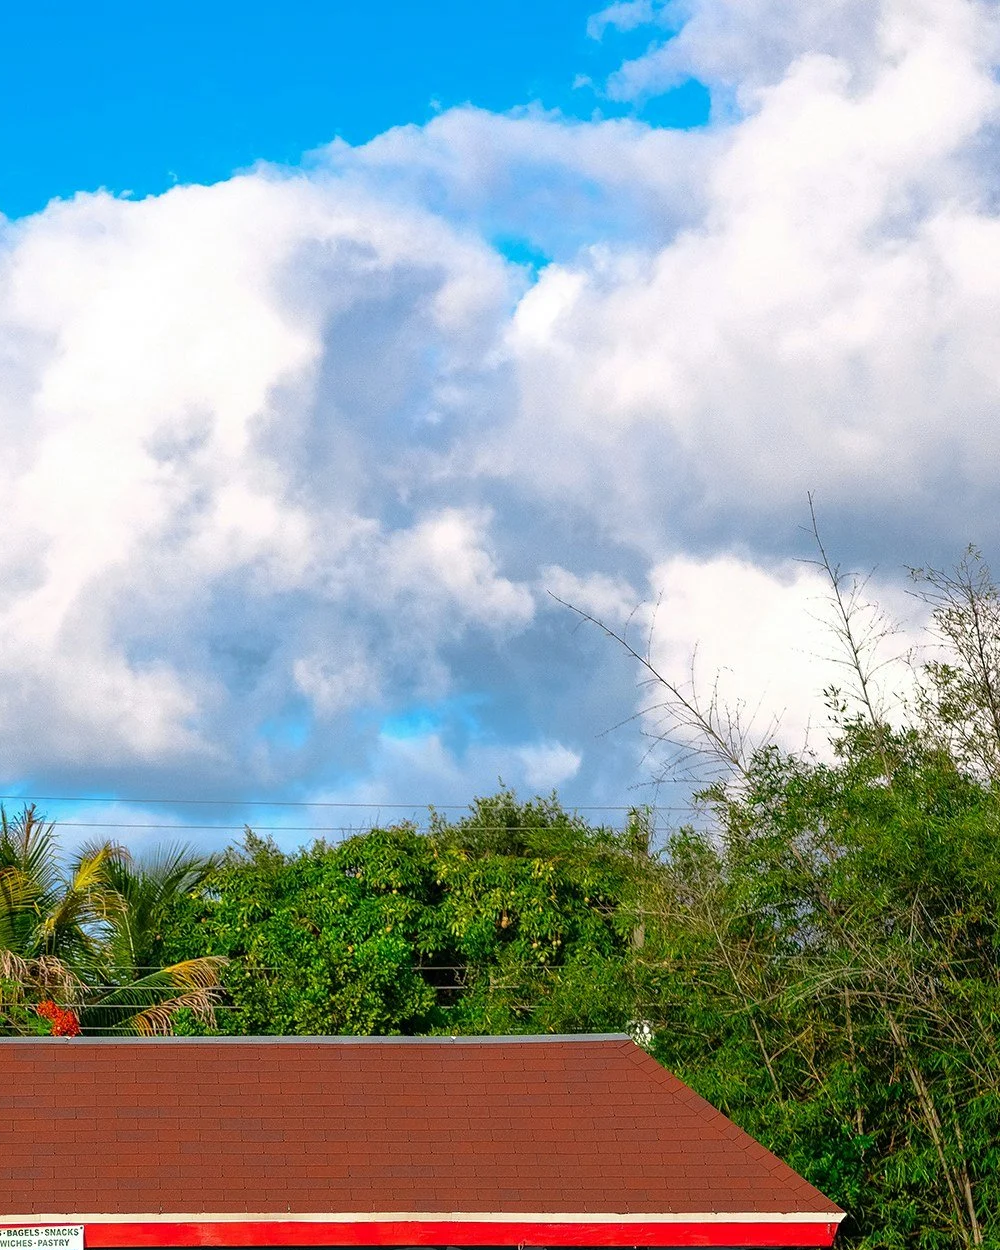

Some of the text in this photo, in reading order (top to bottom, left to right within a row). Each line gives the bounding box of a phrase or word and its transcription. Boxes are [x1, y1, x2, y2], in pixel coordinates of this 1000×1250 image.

[6, 1229, 40, 1237] BAGELS
[44, 1228, 79, 1236] SNACKS
[37, 1239, 70, 1247] PASTRY
